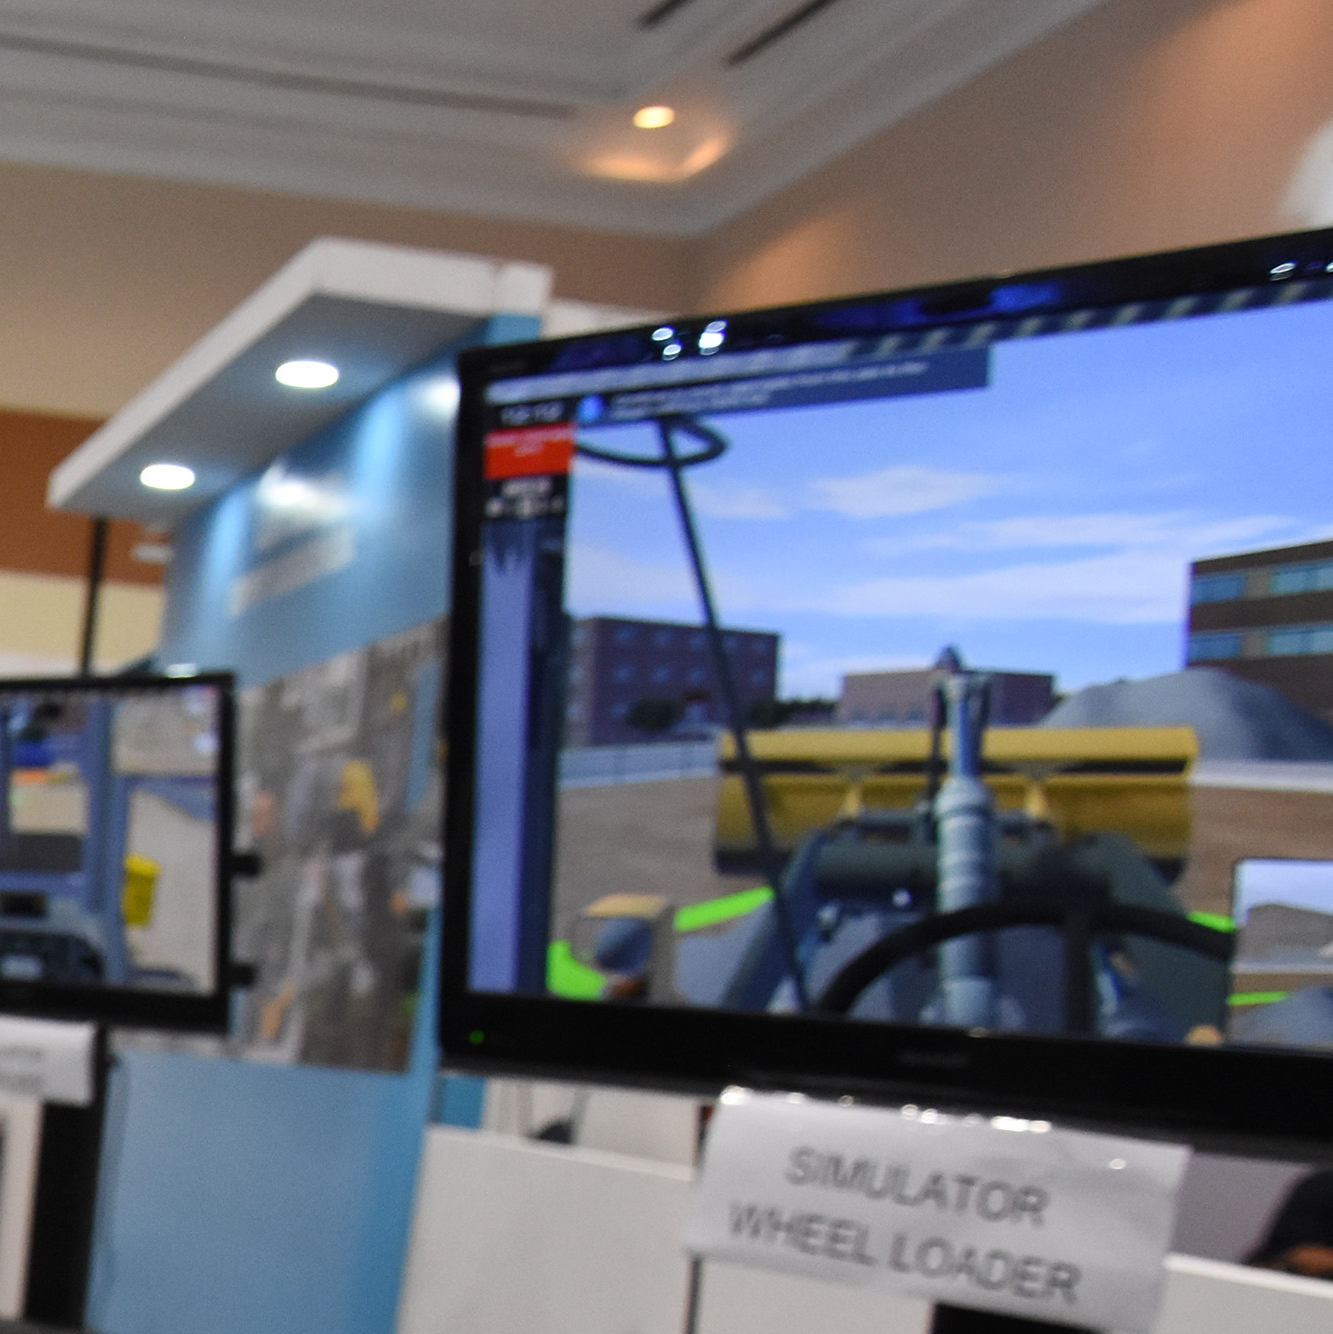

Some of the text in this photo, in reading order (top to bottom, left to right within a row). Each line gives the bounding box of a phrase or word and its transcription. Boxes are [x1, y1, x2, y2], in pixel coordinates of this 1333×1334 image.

[786, 1145, 1051, 1227] SIMULATOR
[730, 1204, 1083, 1304] WHEEL LOADER
